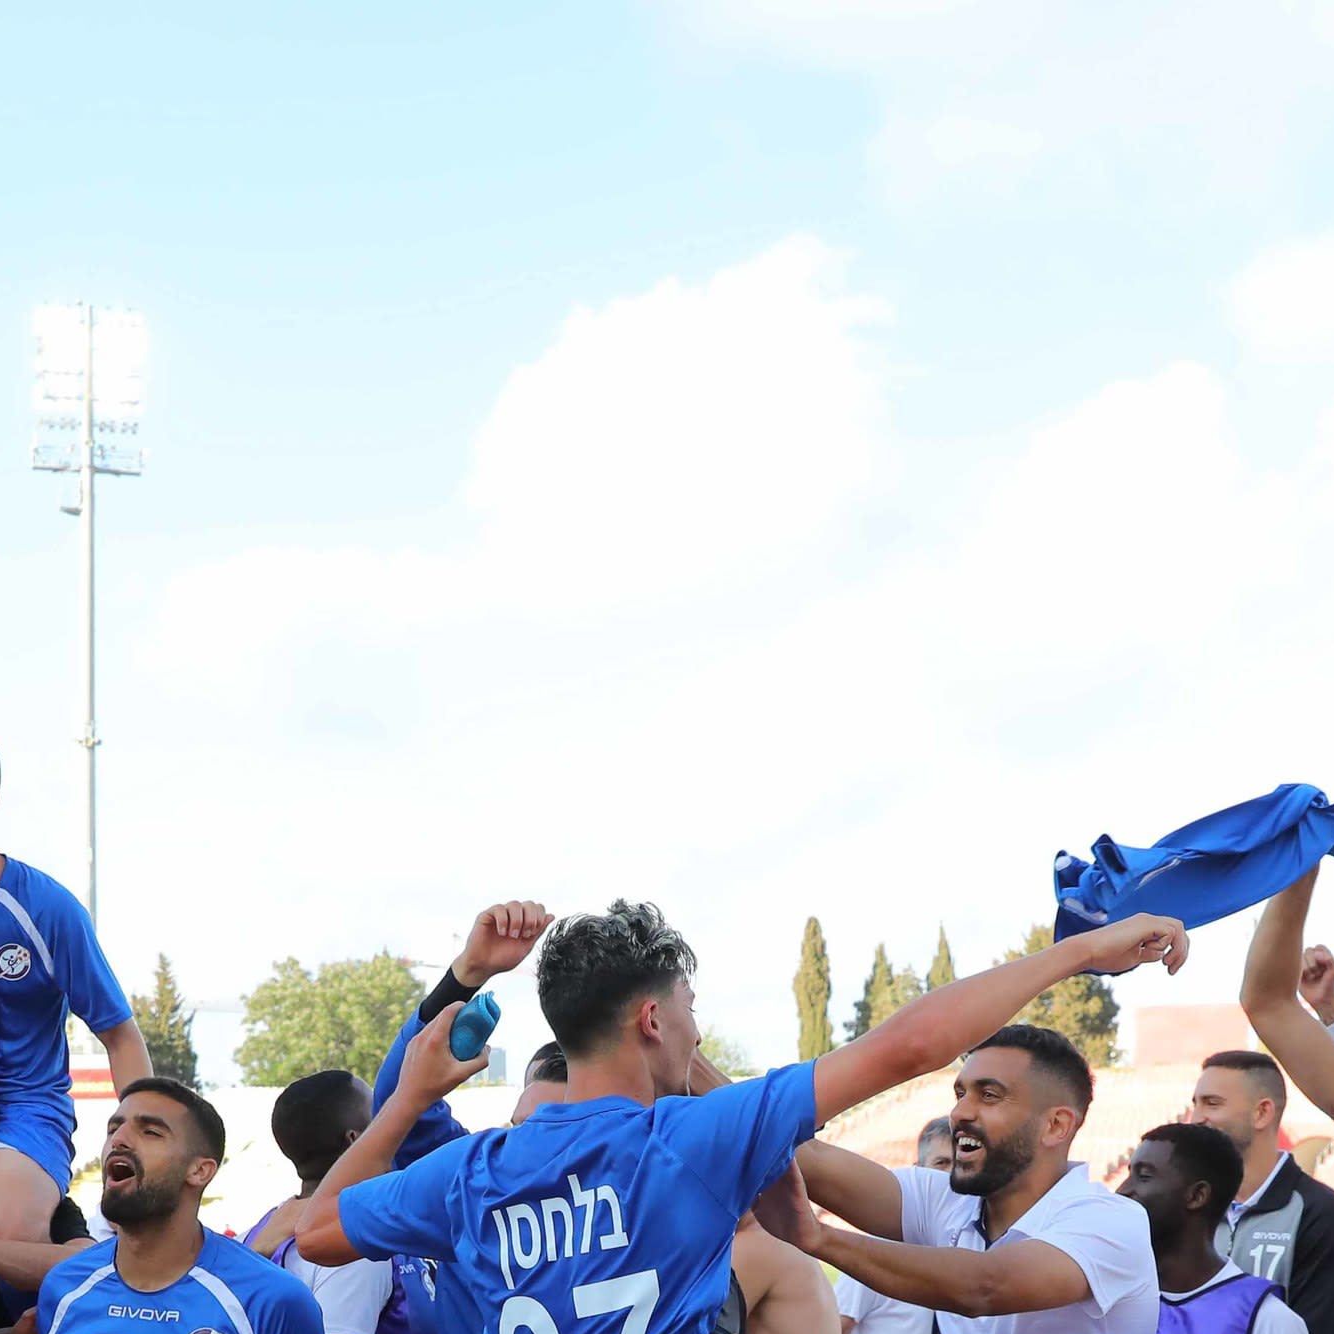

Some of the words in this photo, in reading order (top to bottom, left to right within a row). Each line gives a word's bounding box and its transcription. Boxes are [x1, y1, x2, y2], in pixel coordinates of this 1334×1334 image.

[491, 1173, 629, 1290] בלחסן
[1252, 1232, 1291, 1240] GIVOVA
[1249, 1244, 1285, 1280] 17
[108, 1305, 180, 1322] GIVOVA
